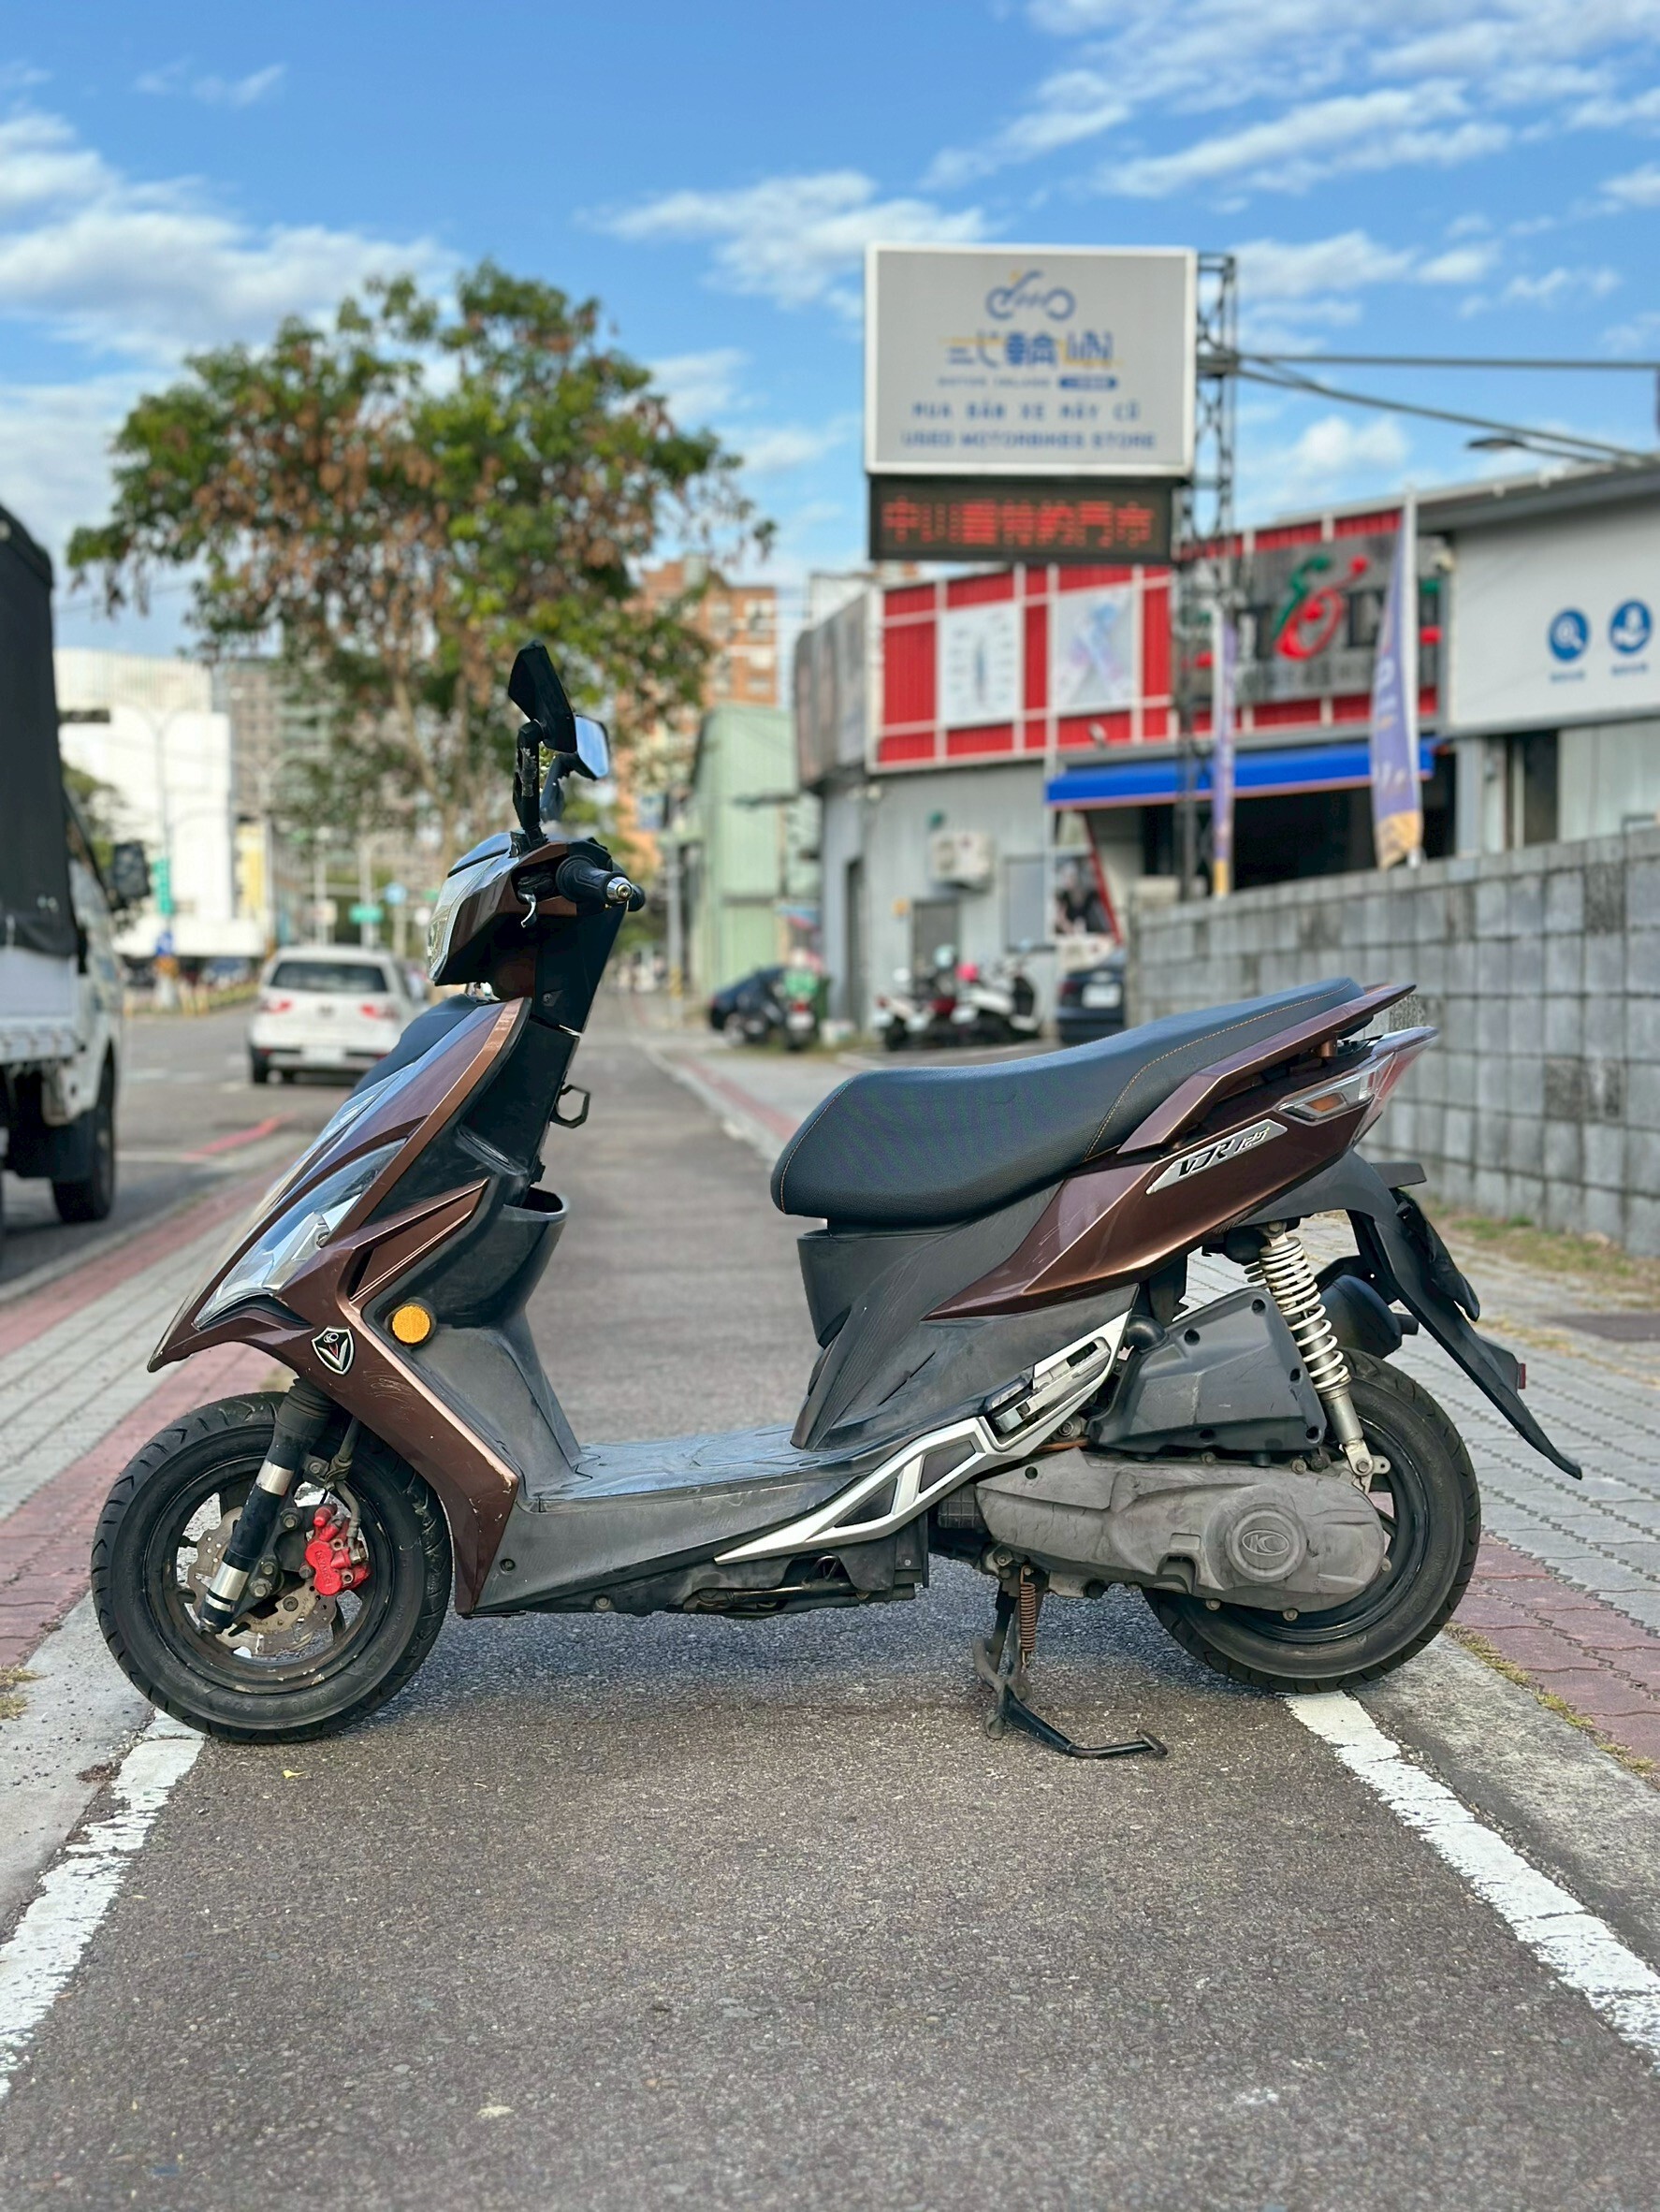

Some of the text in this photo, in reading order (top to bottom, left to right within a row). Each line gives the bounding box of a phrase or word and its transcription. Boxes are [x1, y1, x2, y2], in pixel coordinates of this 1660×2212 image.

[901, 430, 1156, 450] USED MOTORBIKES STORE
